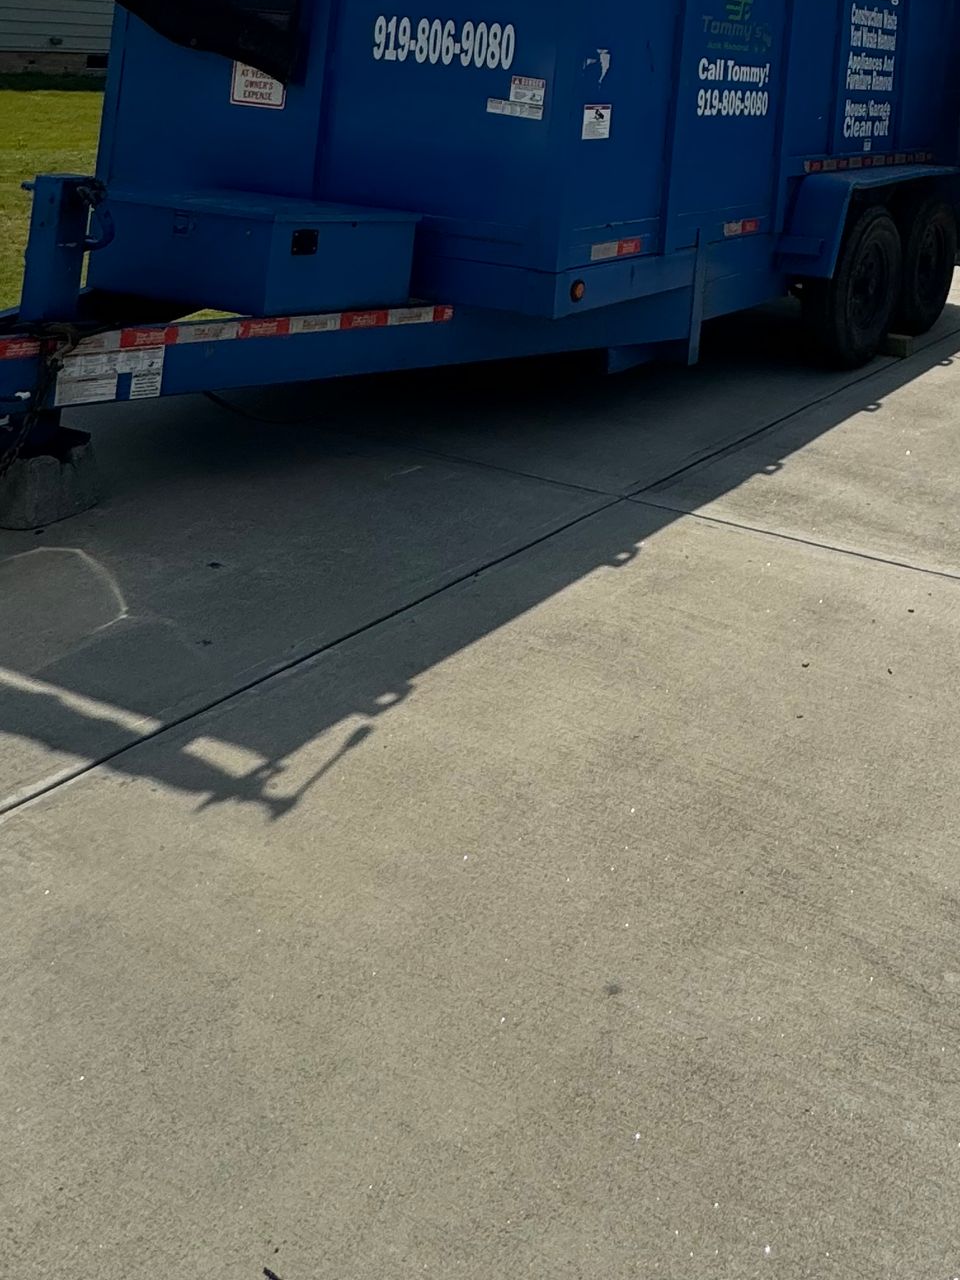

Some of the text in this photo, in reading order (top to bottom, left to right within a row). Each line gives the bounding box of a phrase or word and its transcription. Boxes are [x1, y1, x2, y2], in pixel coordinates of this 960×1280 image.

[851, 4, 897, 30] Construction Waste
[372, 14, 516, 71] 919-806-9080
[850, 25, 896, 50] Yard Waste Removal
[698, 57, 771, 88] Call Tommy!
[848, 51, 895, 73] Appliances And
[244, 79, 274, 90] OWNER'S
[846, 69, 894, 91] Furniture Removal
[243, 90, 273, 101] EXPENSE
[696, 88, 769, 117] 919-806-9080
[843, 116, 890, 138] Clean out
